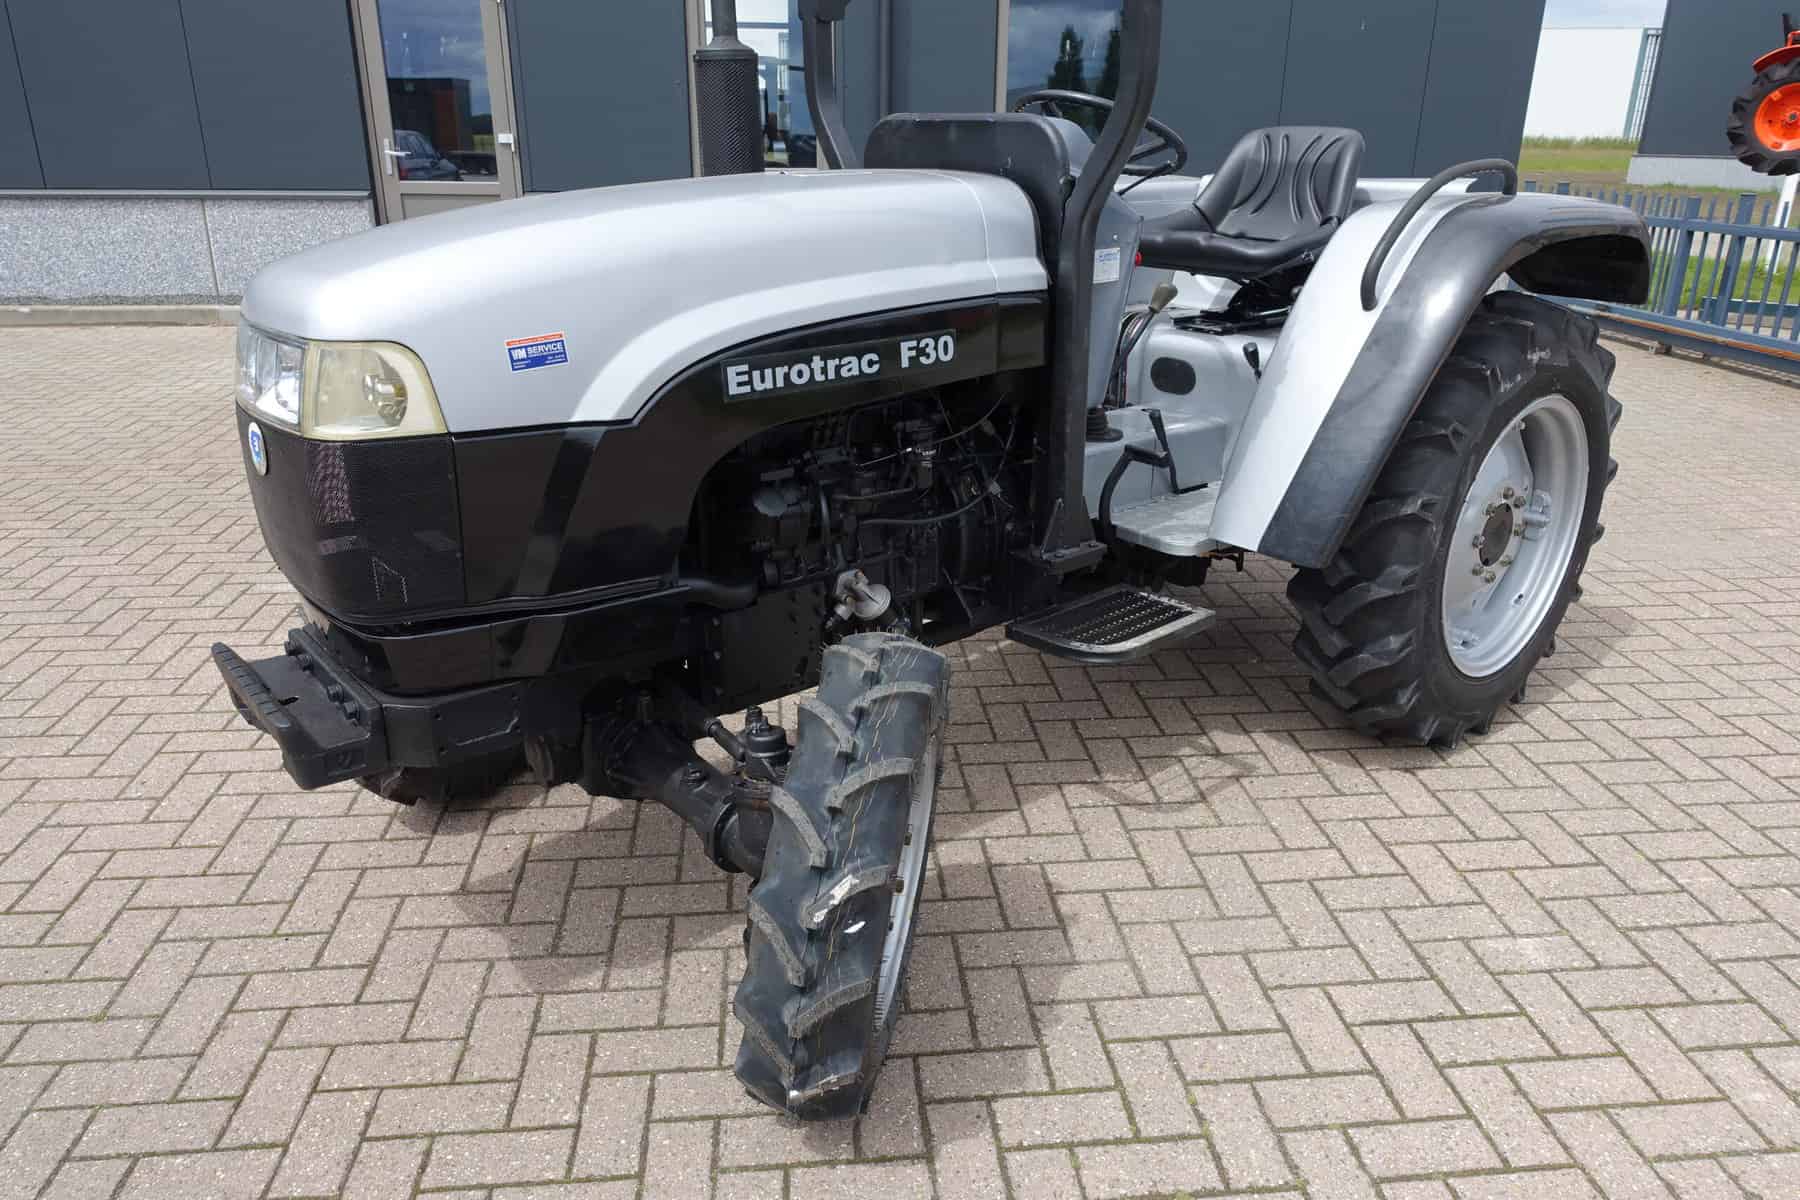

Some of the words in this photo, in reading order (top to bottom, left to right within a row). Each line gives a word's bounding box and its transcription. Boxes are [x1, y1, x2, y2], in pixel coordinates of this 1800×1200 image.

[528, 342, 563, 354] SERVICE
[727, 353, 880, 395] Eurotrac
[900, 335, 954, 368] F30
